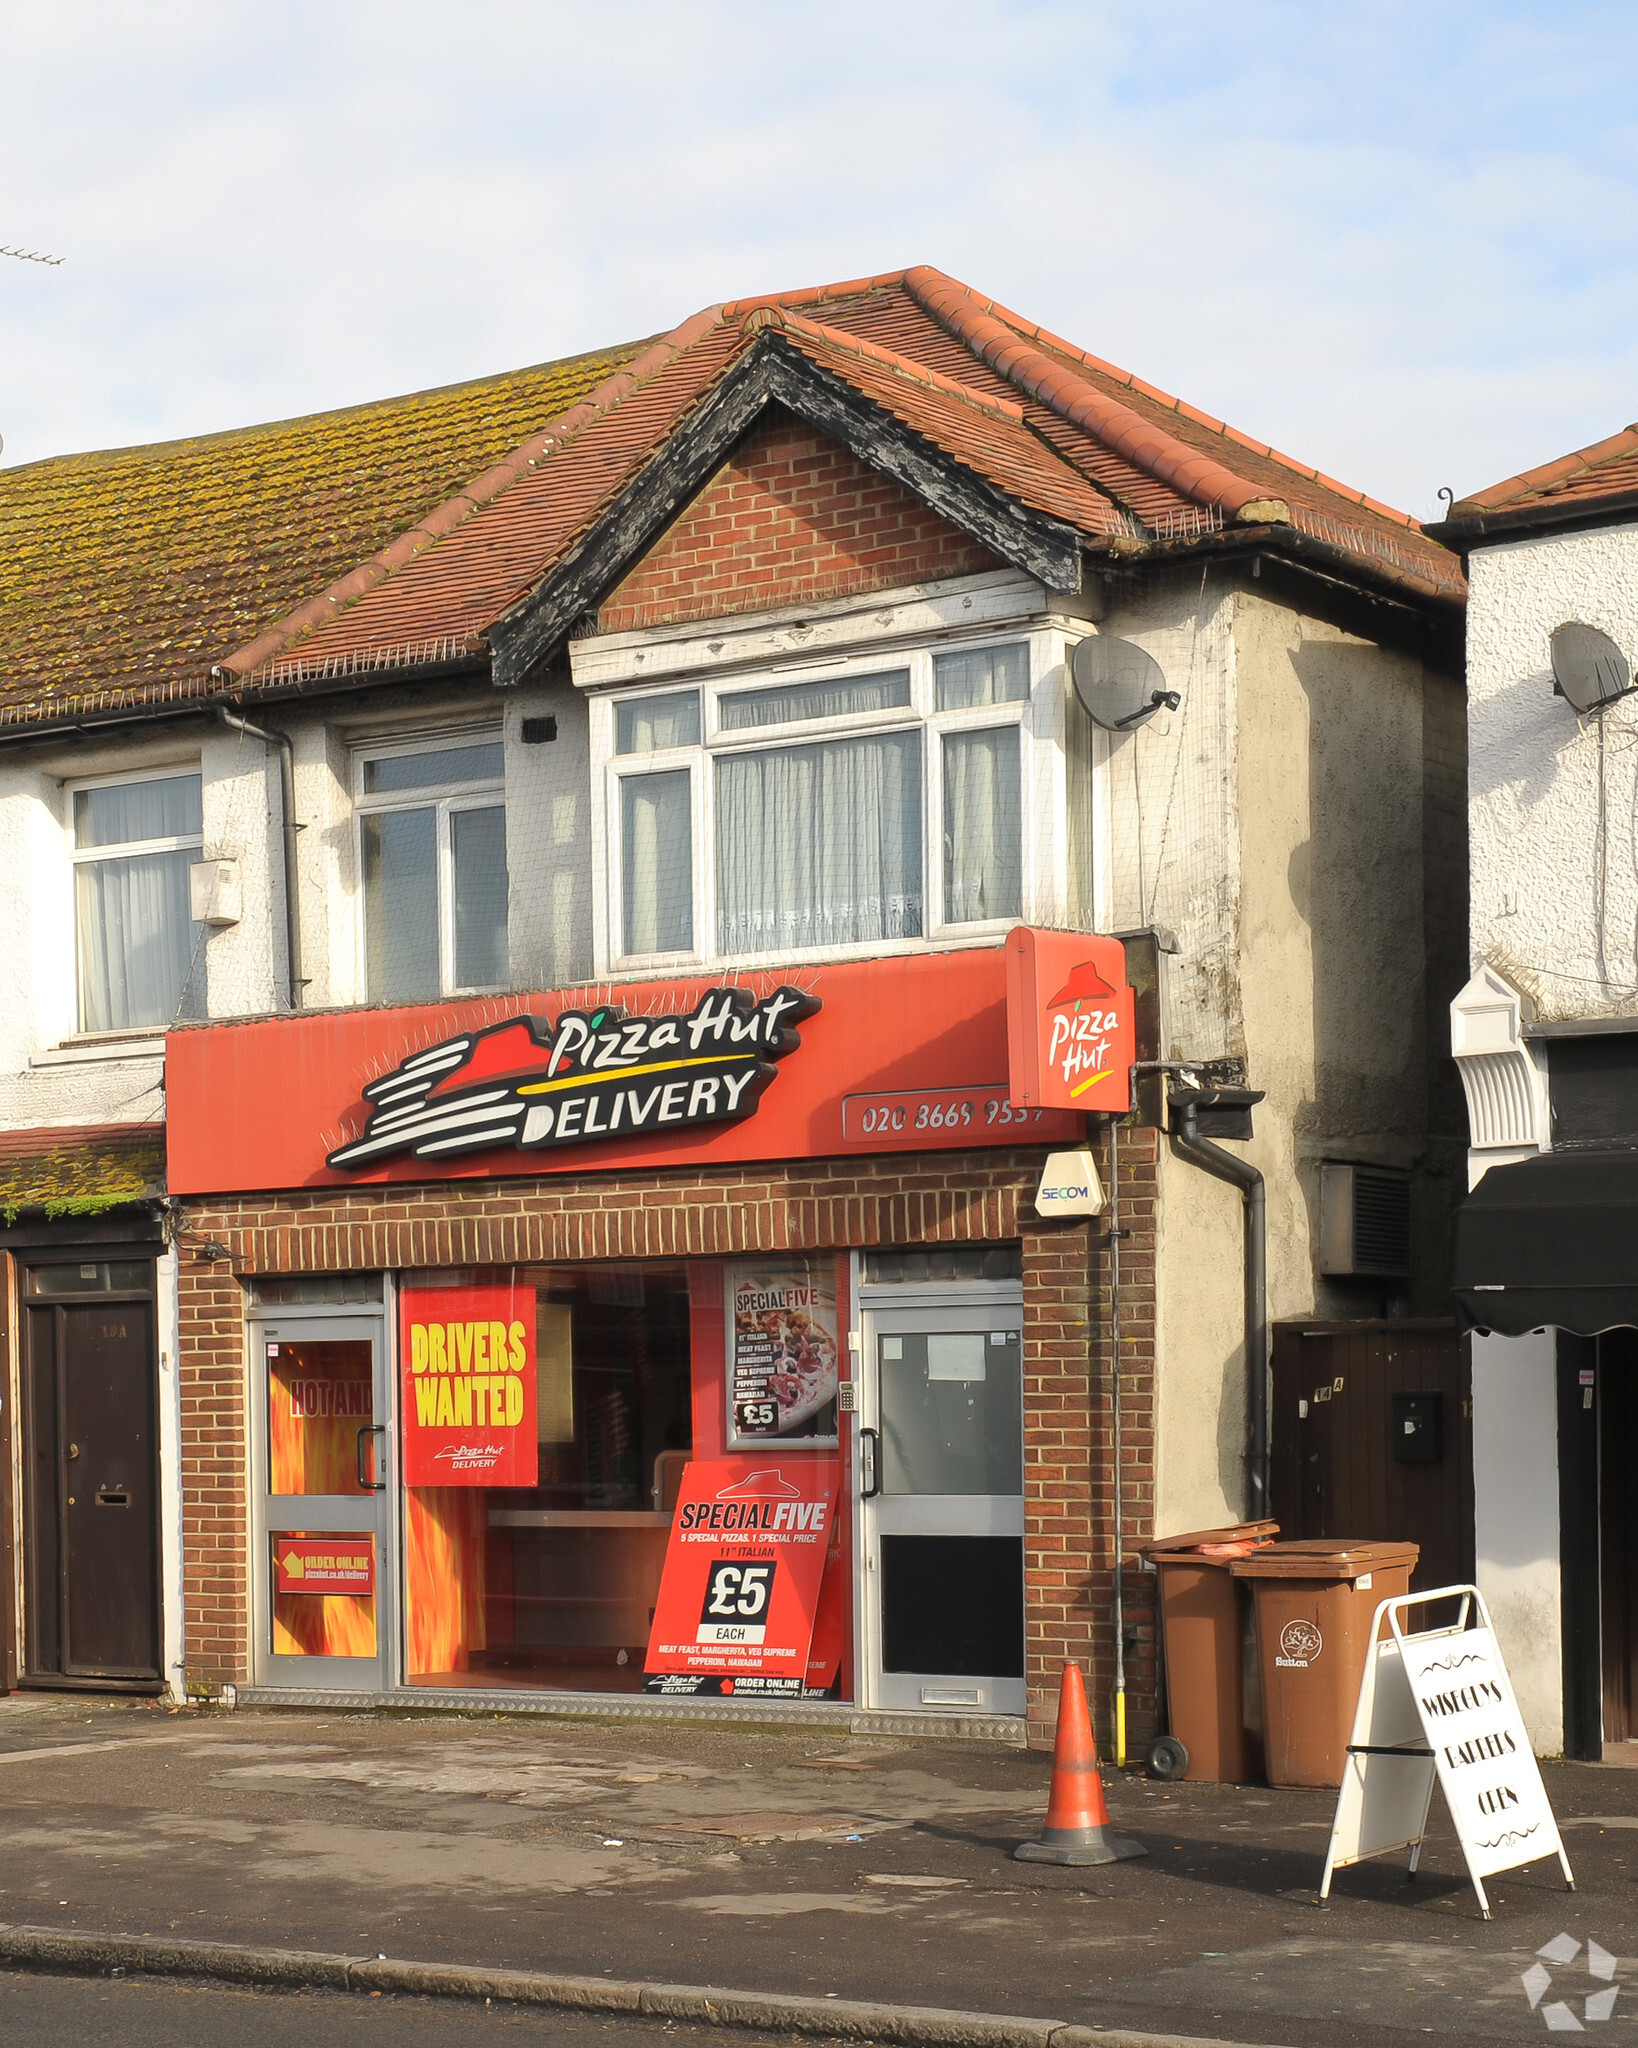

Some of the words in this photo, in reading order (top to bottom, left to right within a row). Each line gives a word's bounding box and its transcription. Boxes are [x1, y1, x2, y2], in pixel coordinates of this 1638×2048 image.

[547, 1013, 679, 1077] Pizza
[687, 995, 798, 1049] Hut
[1050, 1001, 1119, 1066] Pizza
[1062, 1038, 1111, 1083] Hut
[522, 1070, 756, 1143] DELIVERY
[862, 1105, 906, 1133] 020
[915, 1101, 974, 1129] 8669
[1042, 1187, 1088, 1199] SECOM
[411, 1320, 527, 1374] DRIVERS
[1335, 1378, 1342, 1391] A
[290, 1379, 330, 1417] HOT
[414, 1375, 524, 1428] WANTED
[743, 1404, 774, 1424] £5
[459, 1445, 483, 1456] Pizza
[485, 1444, 505, 1455] Hut
[452, 1459, 497, 1469] DELIVERY
[681, 1534, 686, 1542] 5
[687, 1534, 719, 1542] SPECIAL
[758, 1534, 791, 1543] SPECIAL
[793, 1534, 817, 1543] PRICE
[737, 1547, 776, 1557] ITALIAN
[305, 1556, 336, 1569] ORDER
[336, 1556, 369, 1570] ONLINE
[709, 1567, 769, 1615] £5
[716, 1628, 745, 1640] EACH
[659, 1645, 677, 1653] MEAT
[748, 1647, 763, 1656] VEG
[763, 1648, 797, 1657] SUPREME
[1276, 1656, 1309, 1668] Sutton
[667, 1675, 688, 1684] Pizza
[689, 1676, 704, 1684] Hut
[734, 1678, 766, 1688] ORDER
[766, 1679, 800, 1689] ONLINE
[661, 1686, 697, 1694] DELIVERY
[733, 1688, 798, 1698] pizzahut.co.uk/delivery
[1421, 1680, 1502, 1718] WISEGUYS
[1444, 1730, 1516, 1770] BARBERS
[1478, 1785, 1519, 1815] OPEN
